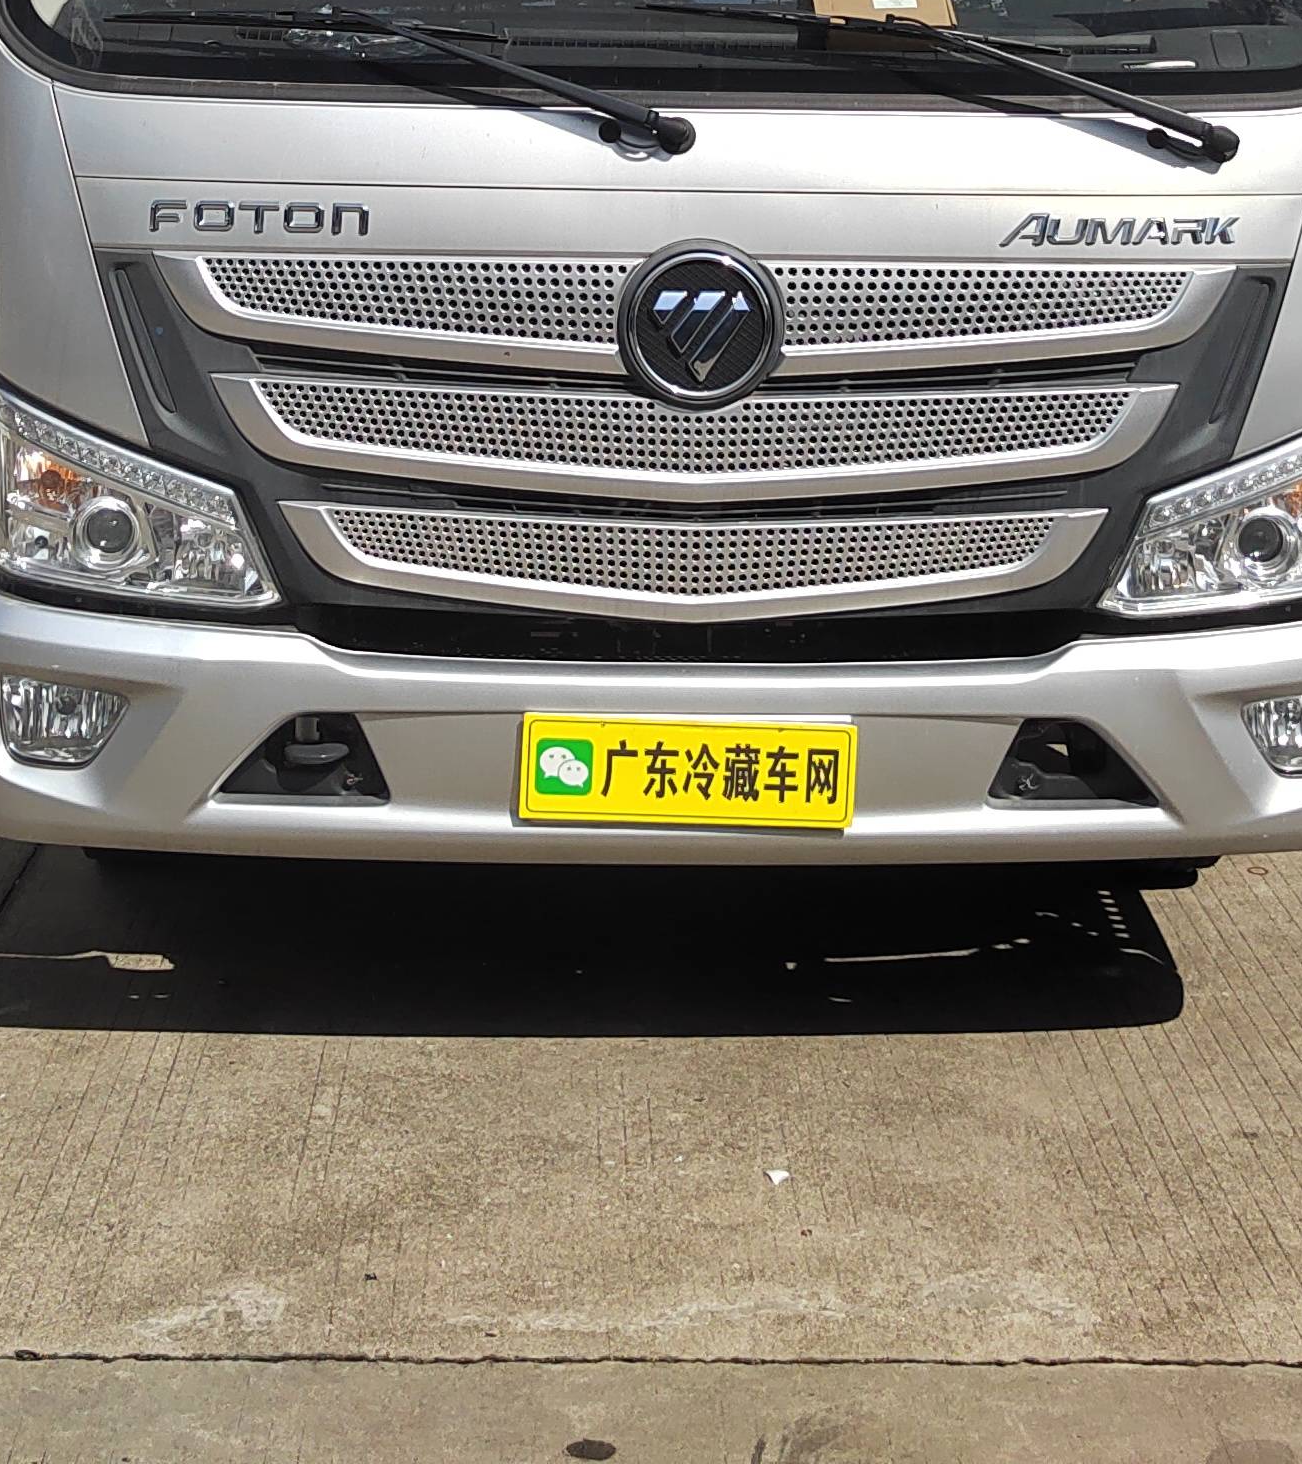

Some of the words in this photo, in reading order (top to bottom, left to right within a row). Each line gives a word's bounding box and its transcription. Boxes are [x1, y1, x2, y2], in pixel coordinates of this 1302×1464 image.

[149, 199, 370, 236] FOTON
[998, 212, 1241, 247] AUMARK
[600, 739, 840, 804] 广东冷藏车网
